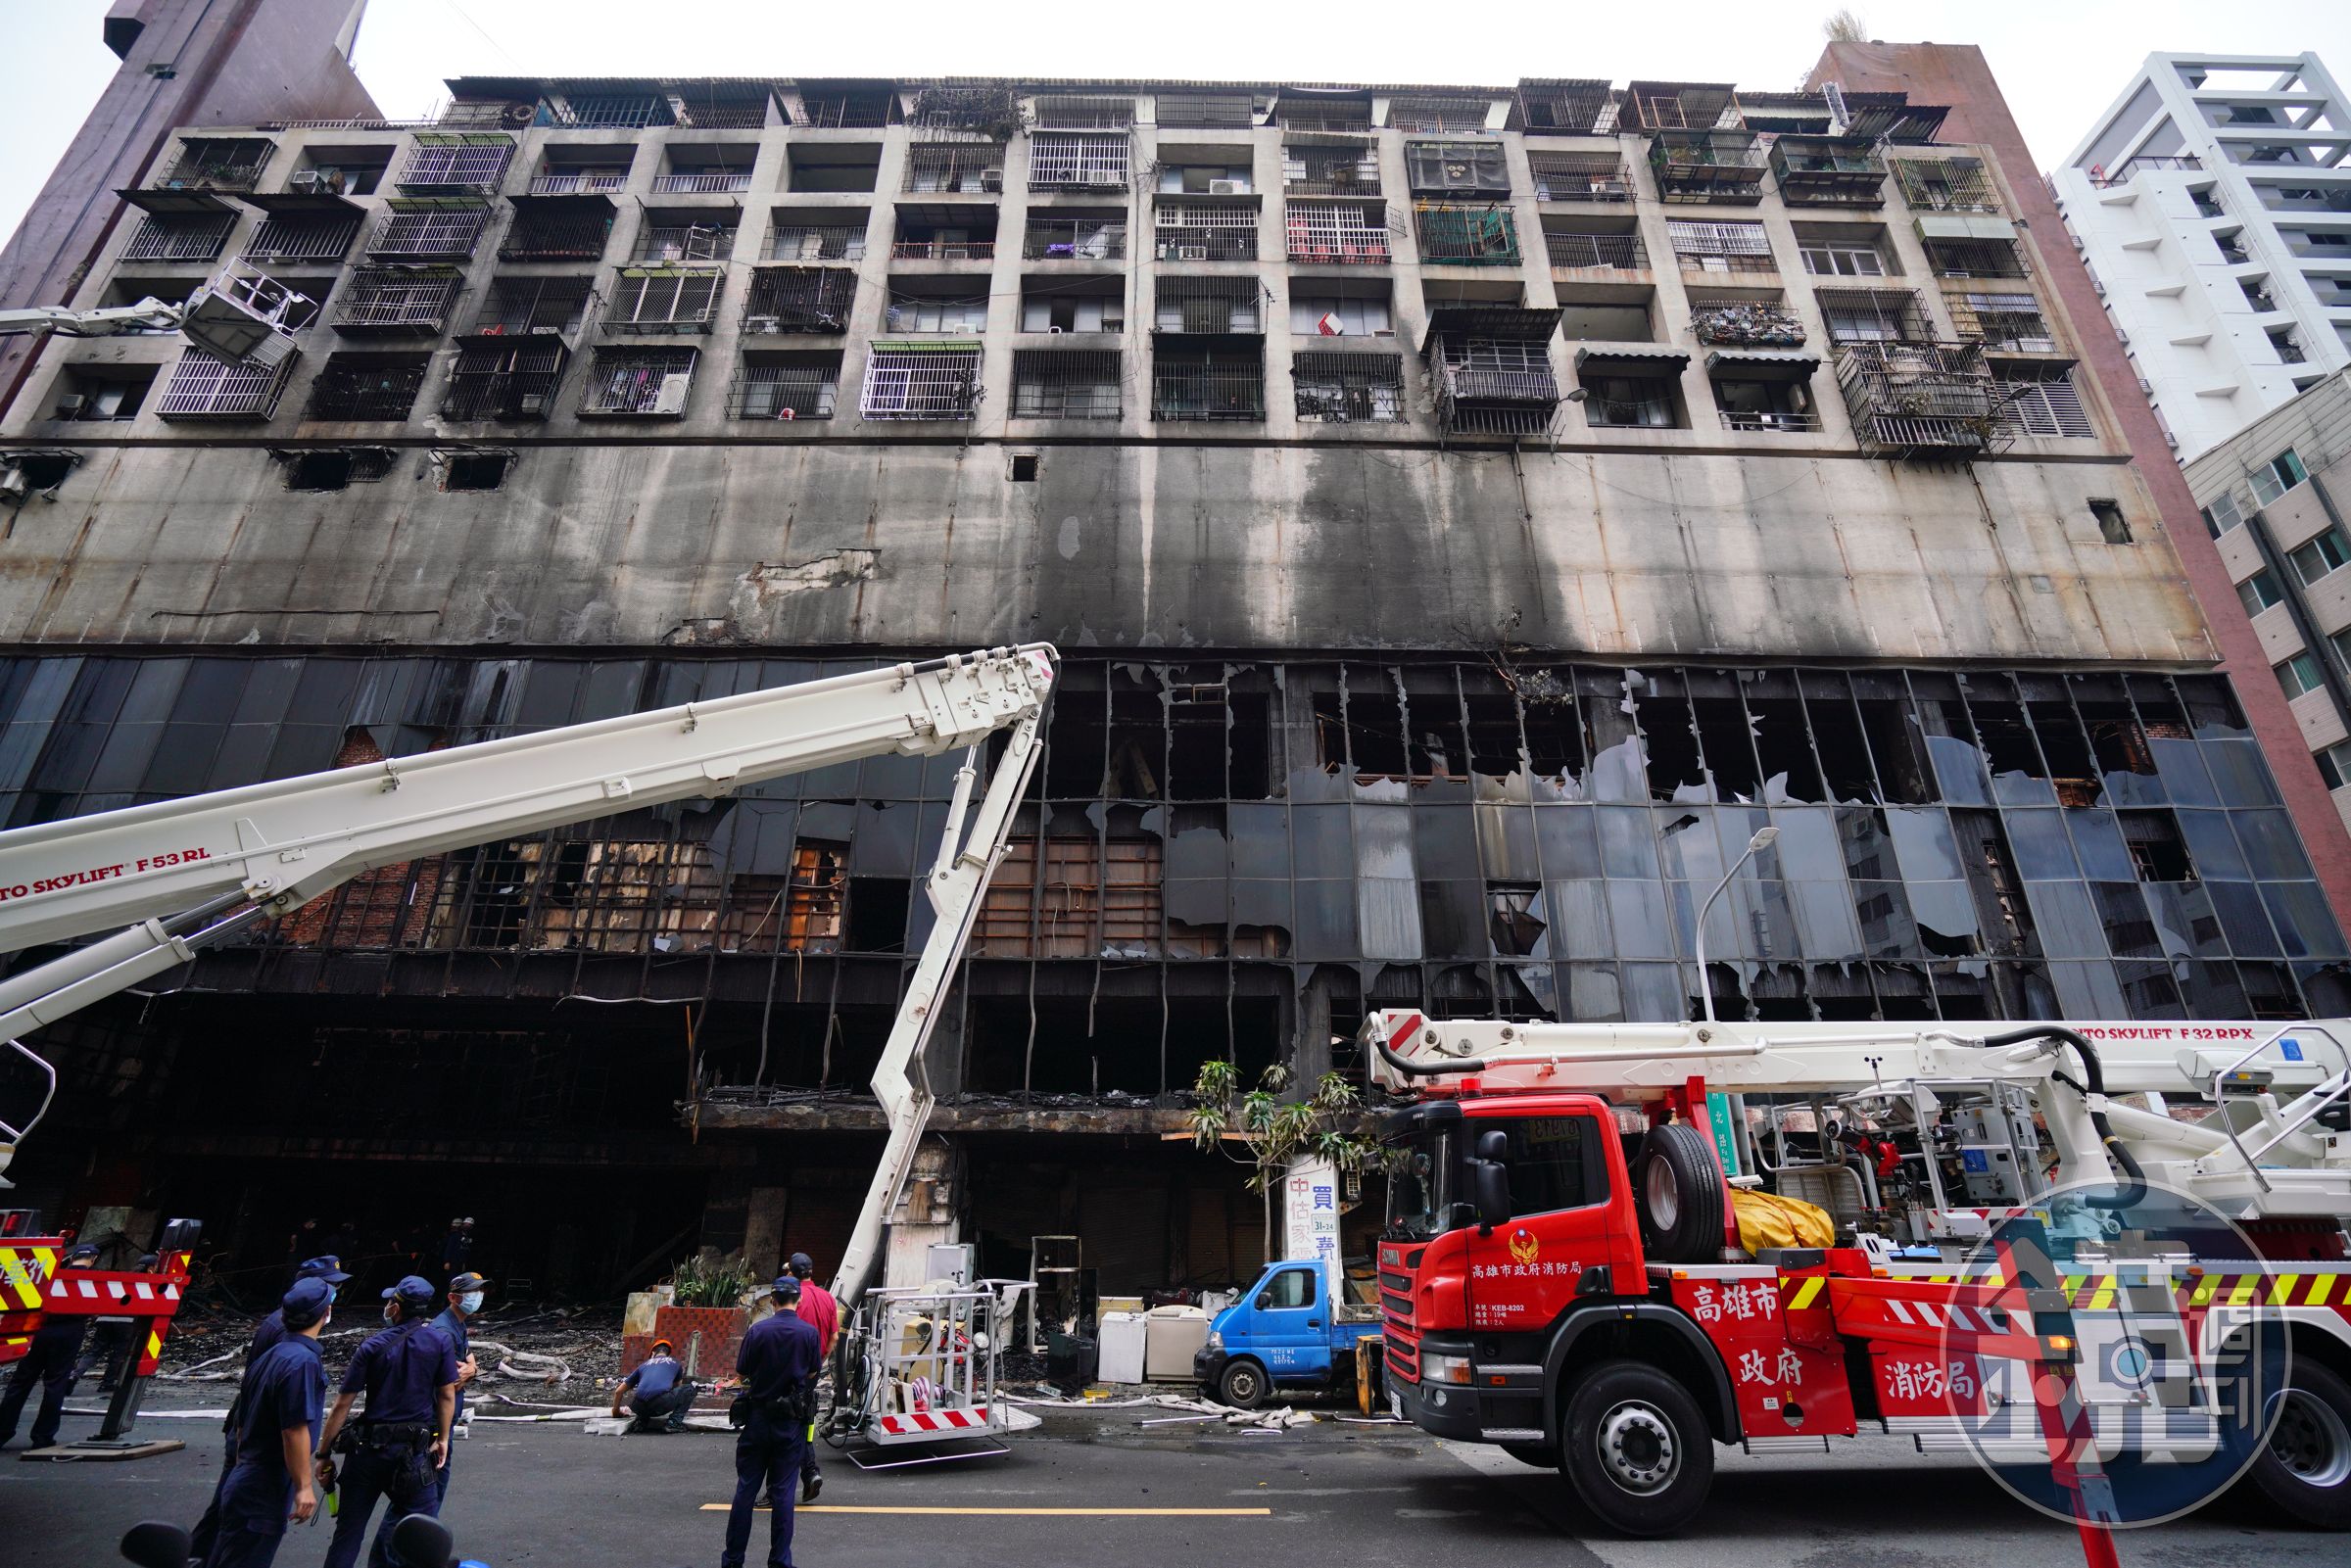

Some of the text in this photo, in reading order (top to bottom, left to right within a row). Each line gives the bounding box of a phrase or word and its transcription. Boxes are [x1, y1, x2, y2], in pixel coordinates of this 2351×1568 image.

[34, 864, 123, 894] SKYLIFT
[2109, 1028, 2173, 1040] SKYLIFT
[1472, 1261, 1582, 1279] 高雄市政府消防局
[1693, 1282, 1778, 1323] 高雄市
[1738, 1347, 1803, 1387] 政府
[1884, 1360, 1975, 1401] 消防局
